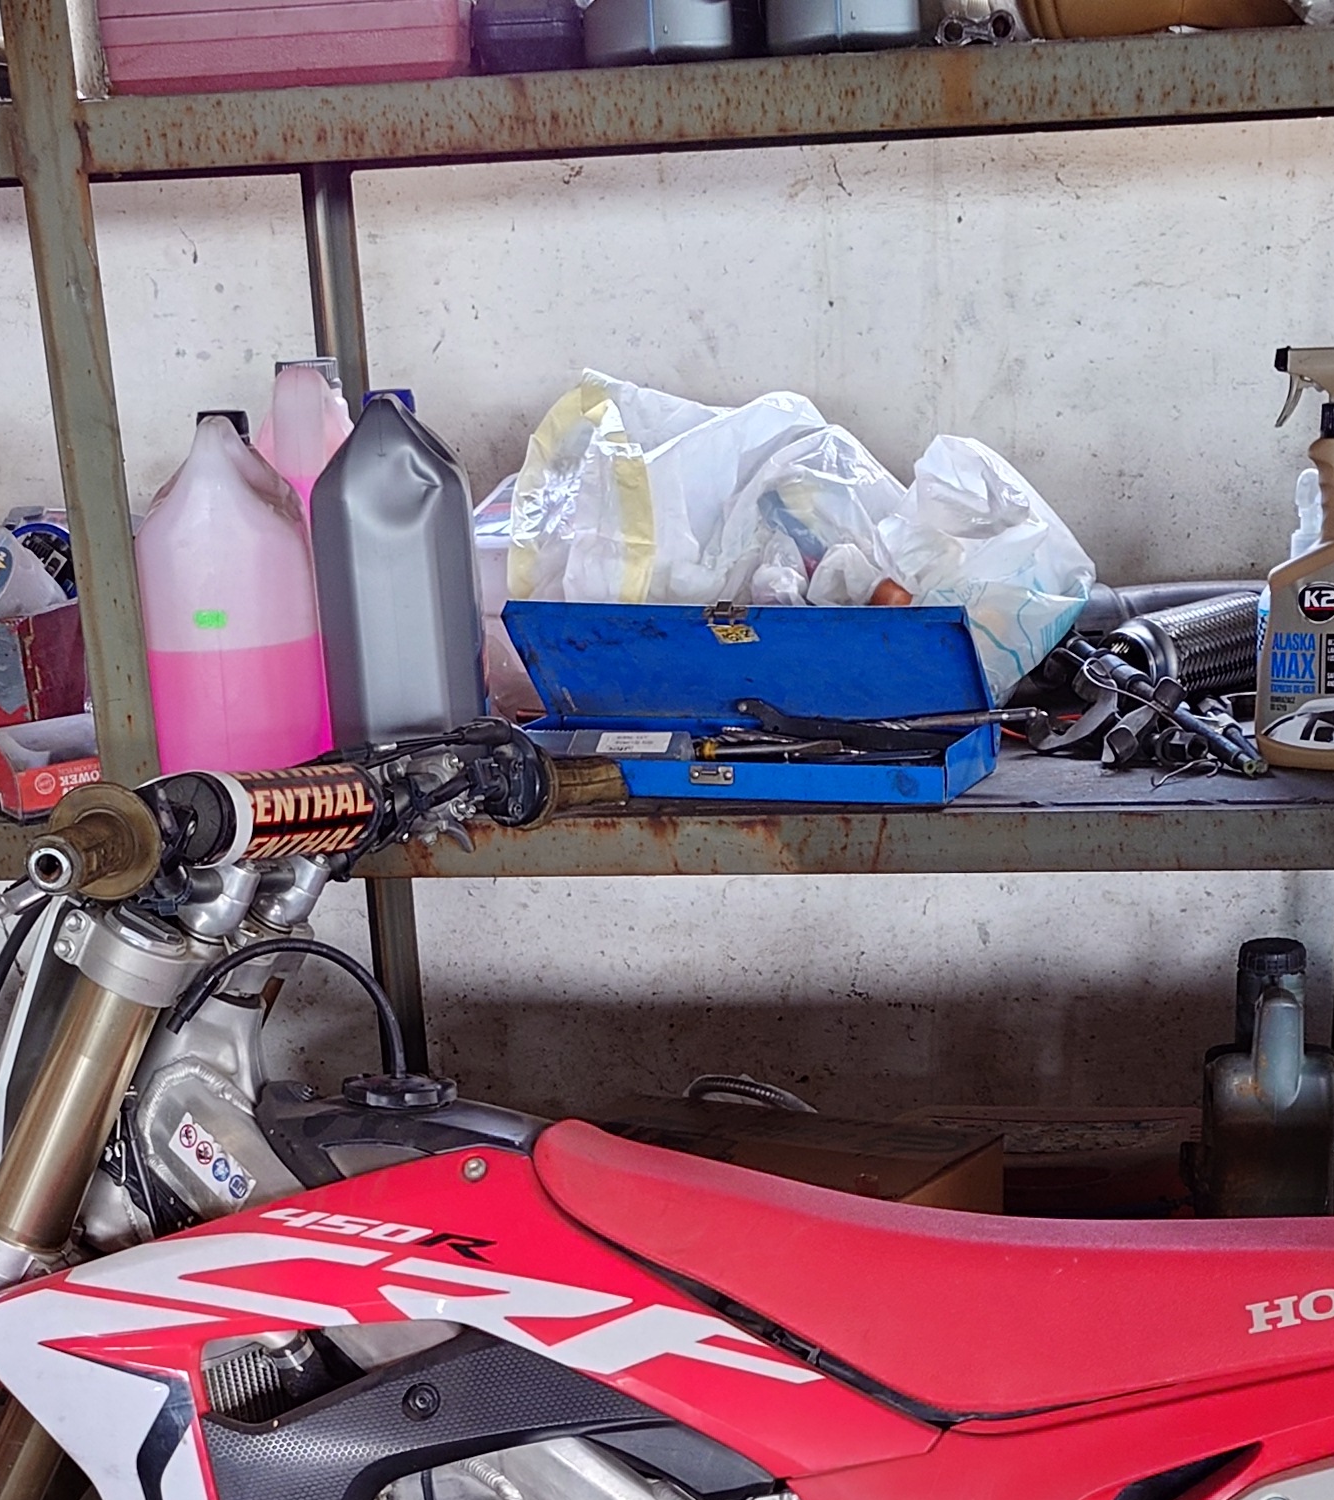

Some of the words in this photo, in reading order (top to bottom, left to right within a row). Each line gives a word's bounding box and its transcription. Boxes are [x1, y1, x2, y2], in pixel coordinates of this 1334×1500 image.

[1272, 633, 1316, 651] ALASKA
[1271, 651, 1316, 680] MAX
[249, 781, 374, 824] ENTHAL
[259, 1208, 497, 1265] 450R
[65, 1232, 826, 1384] CRF
